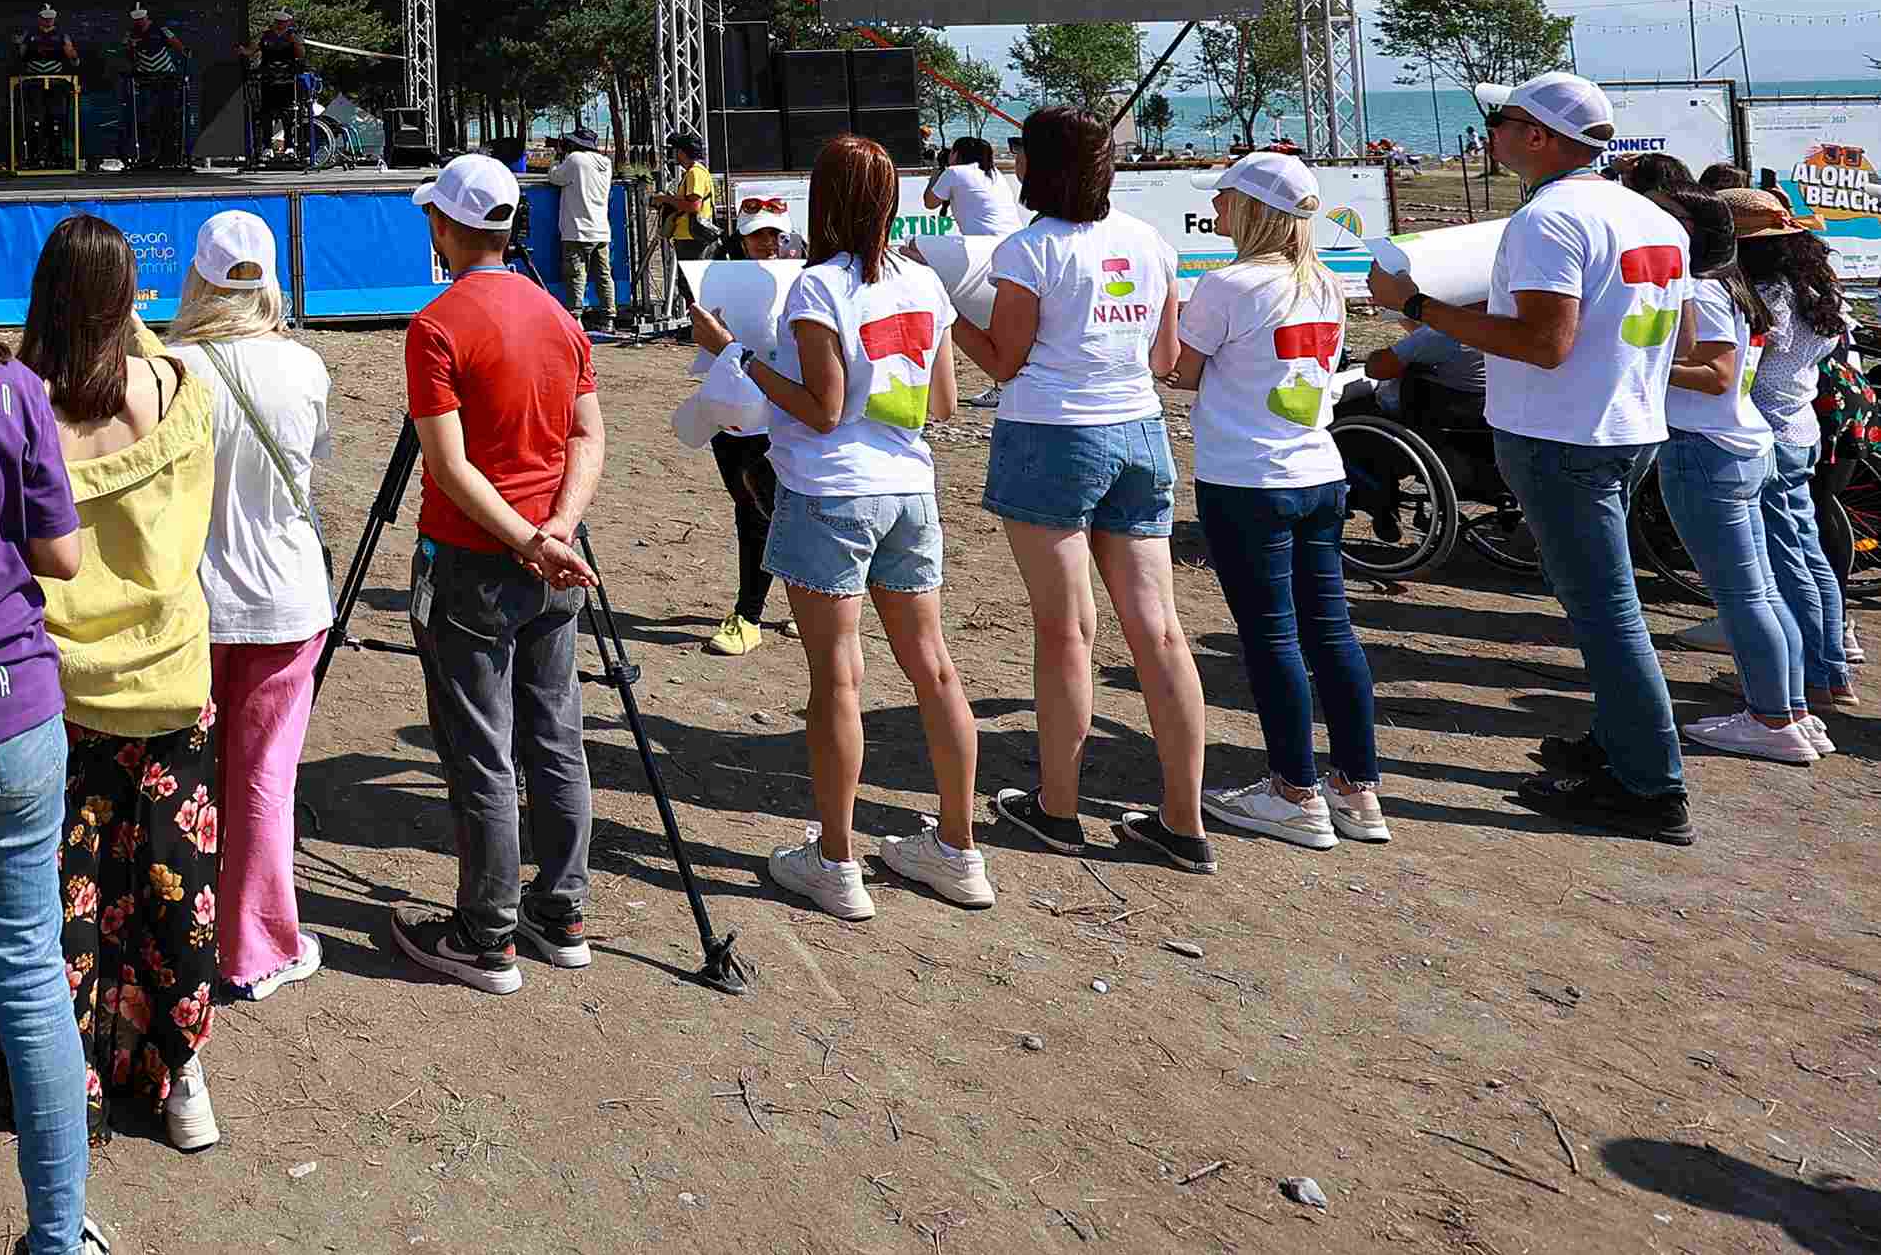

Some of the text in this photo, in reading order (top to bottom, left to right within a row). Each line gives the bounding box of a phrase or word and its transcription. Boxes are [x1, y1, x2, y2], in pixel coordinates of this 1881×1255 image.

[1606, 137, 1666, 152] ONNECT
[1791, 163, 1870, 189] ALOHA
[1805, 186, 1880, 214] BEACH
[889, 215, 954, 240] RTUP
[132, 246, 175, 260] artup
[1093, 304, 1149, 323] NAIR
